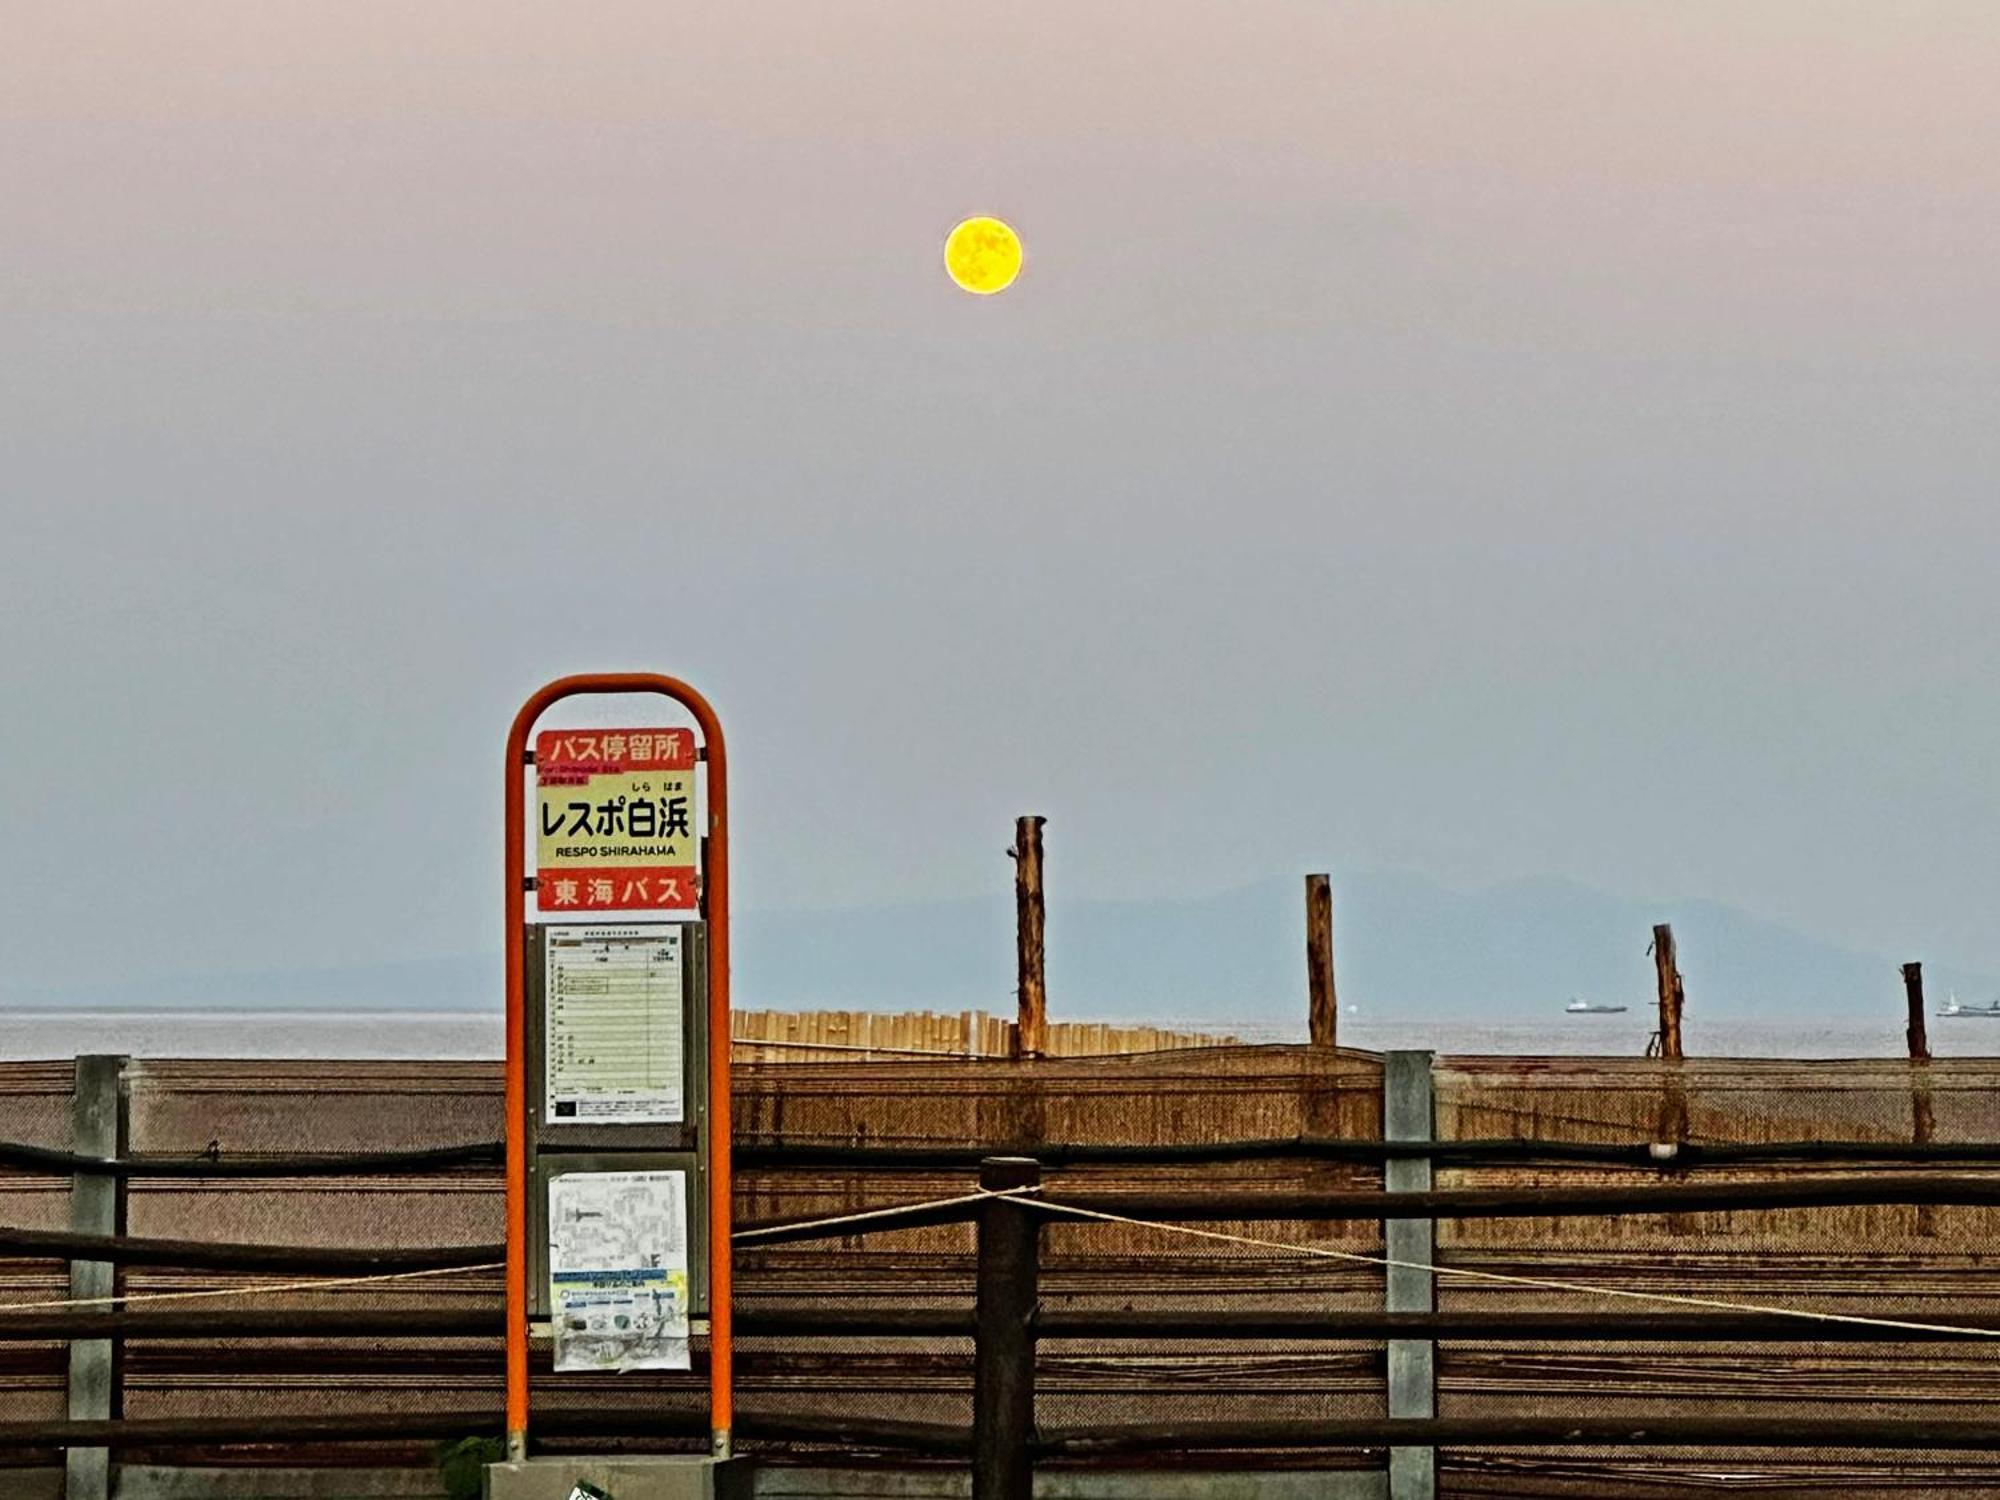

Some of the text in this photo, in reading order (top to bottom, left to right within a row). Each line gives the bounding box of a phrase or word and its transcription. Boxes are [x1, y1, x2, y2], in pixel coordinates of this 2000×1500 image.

[551, 734, 681, 761] バス停留所
[632, 782, 683, 792] しら はま
[542, 795, 689, 838] レスポ白浜
[556, 845, 676, 857] RESPO SHIRAHAMA
[553, 878, 682, 905] 東海バス
